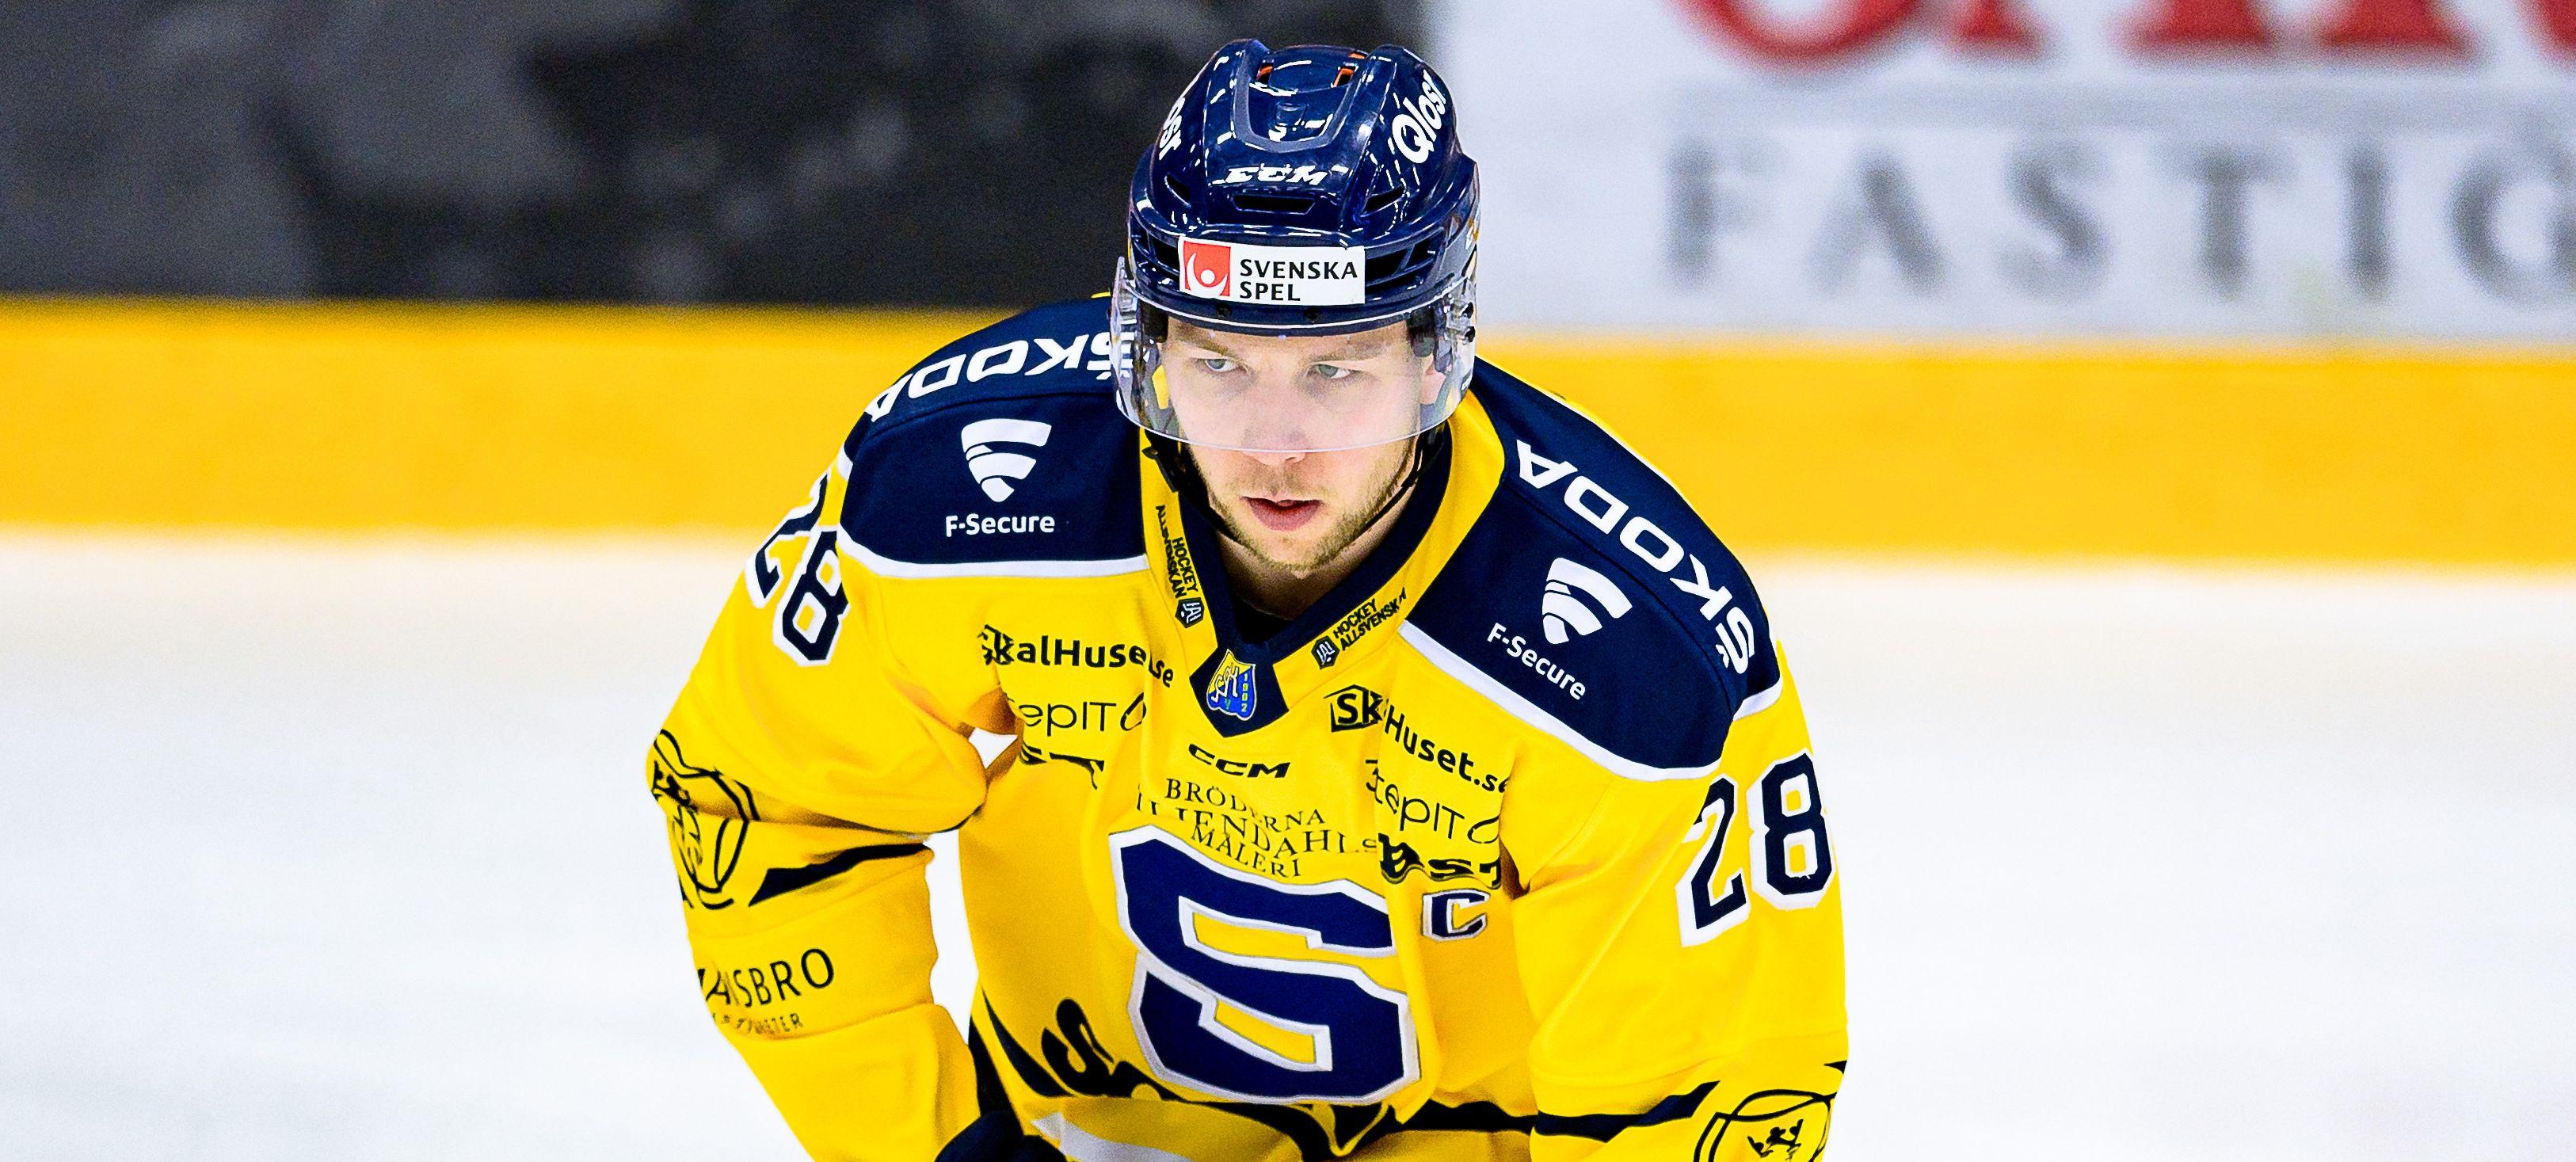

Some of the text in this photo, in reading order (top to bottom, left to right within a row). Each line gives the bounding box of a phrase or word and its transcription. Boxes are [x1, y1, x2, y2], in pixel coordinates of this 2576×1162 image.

[1240, 258, 1358, 280] SVENSKA
[1240, 282, 1301, 302] SPEL
[945, 513, 1056, 538] F-Secure
[745, 467, 852, 668] 28
[1172, 536, 1198, 592] HOCKEY
[1515, 439, 1756, 675] ŠKODA
[1332, 598, 1377, 639] HOCKEY
[1487, 623, 1587, 700] F-Secure
[1188, 743, 1291, 779] CCM
[1164, 778, 1326, 832] BRÖDRNA
[1675, 748, 1835, 948] 28
[1422, 889, 1488, 943] C
[1109, 825, 1421, 1104] S
